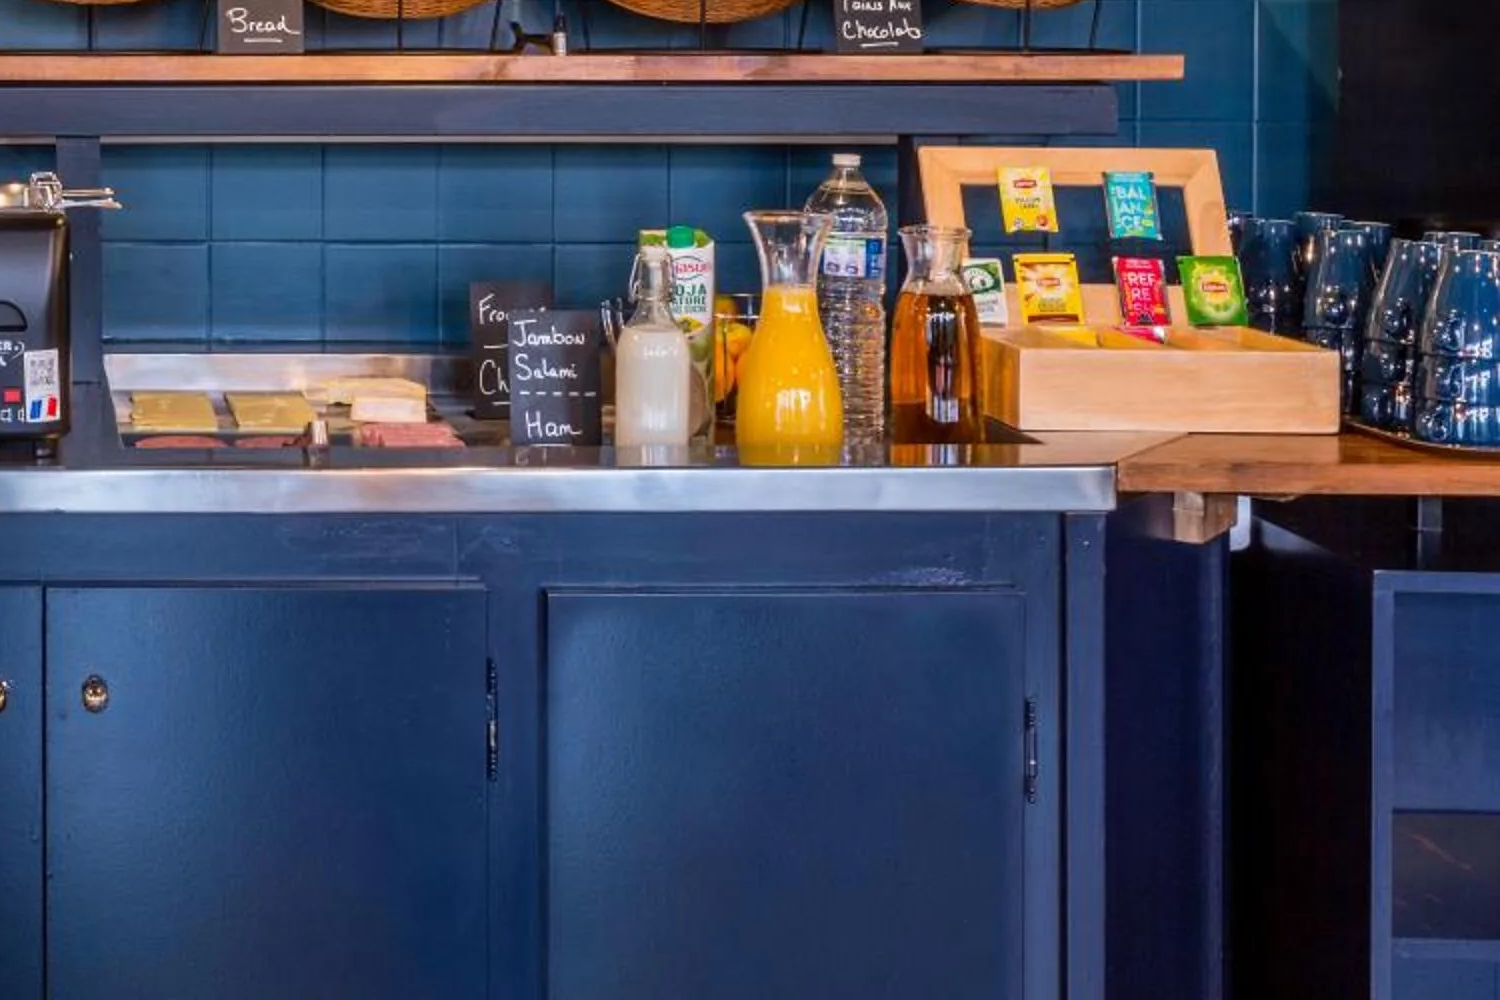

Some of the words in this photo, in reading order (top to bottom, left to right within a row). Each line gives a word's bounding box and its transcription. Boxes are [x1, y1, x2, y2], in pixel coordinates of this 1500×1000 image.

[226, 7, 301, 34] Bread
[675, 283, 706, 297] OJA
[513, 319, 585, 347] Jambon
[515, 353, 578, 380] Salami
[525, 410, 583, 439] Ham
